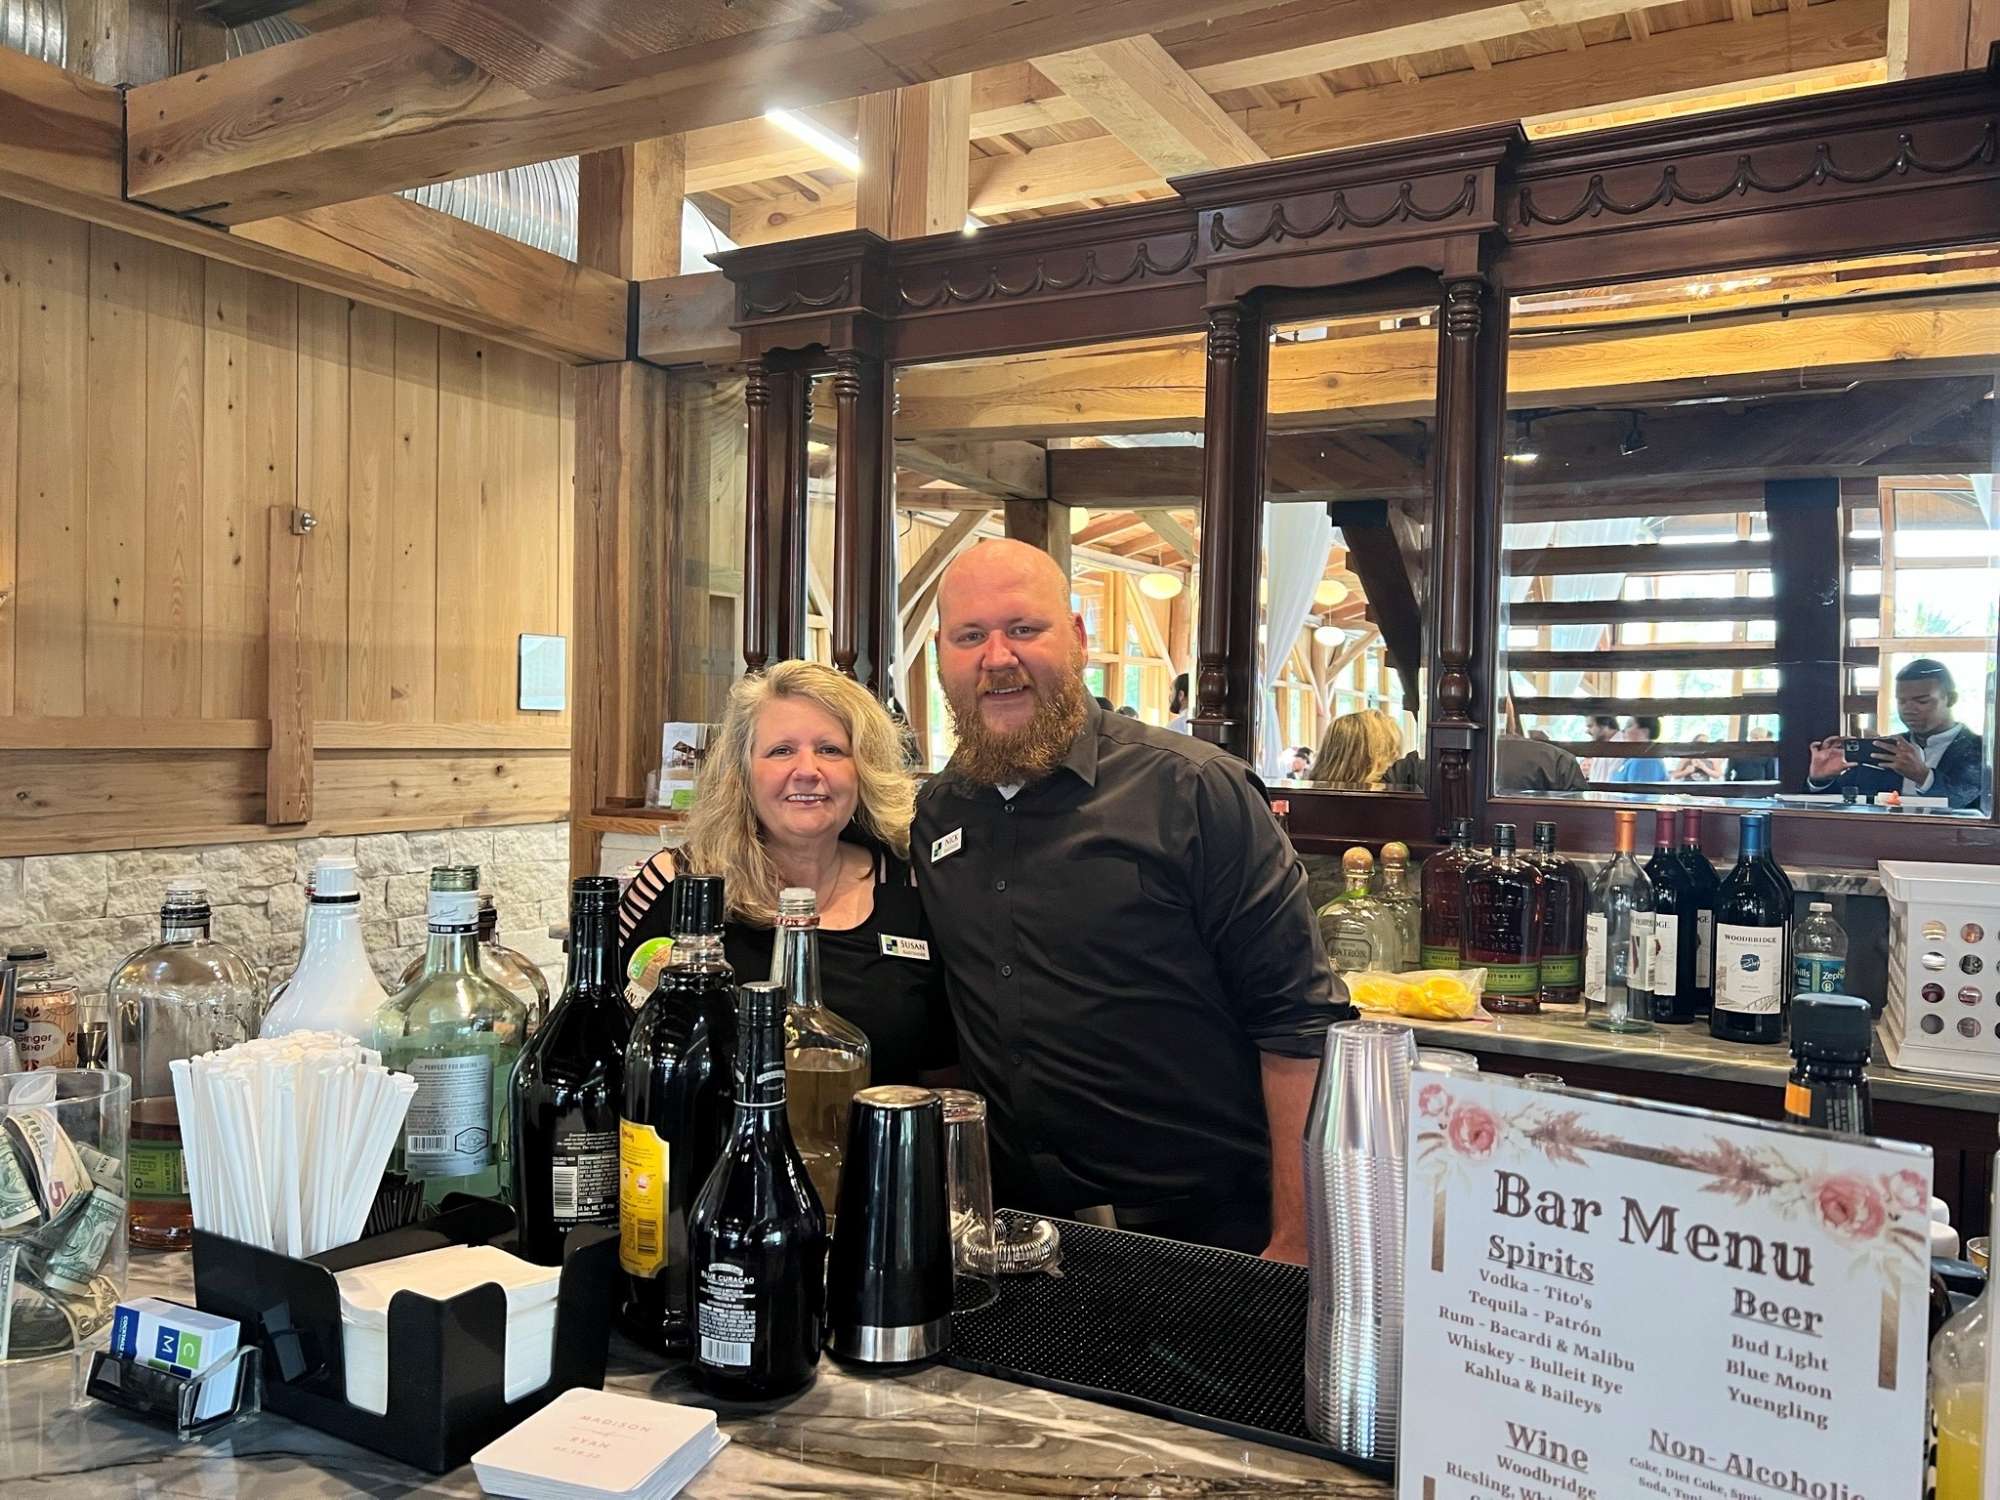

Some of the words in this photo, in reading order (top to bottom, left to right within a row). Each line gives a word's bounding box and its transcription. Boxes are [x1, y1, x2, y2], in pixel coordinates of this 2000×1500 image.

[900, 940, 925, 951] SUSAN
[1724, 933, 1777, 944] WOODBRIDGE
[16, 1034, 52, 1044] Ginger
[20, 1043, 46, 1052] Beer
[1492, 1169, 1602, 1234] Bar
[1618, 1196, 1815, 1286] Menu
[1488, 1234, 1595, 1283] Spirits
[1479, 1268, 1529, 1293] Vodka
[1544, 1285, 1592, 1310] Tito's
[1468, 1290, 1528, 1317] Tequila
[1544, 1310, 1602, 1338] Patrón
[1732, 1287, 1823, 1335] Beer
[163, 1335, 175, 1353] M
[183, 1342, 195, 1359] C
[1438, 1305, 1475, 1327] Rum
[1489, 1319, 1551, 1349] Bacardi
[1556, 1338, 1569, 1353] &
[1573, 1343, 1635, 1372] Malibu
[1731, 1333, 1769, 1356] Bud
[1775, 1344, 1830, 1372] Light
[1447, 1331, 1514, 1364] Whiskey
[1530, 1355, 1586, 1383] Bulleit
[1591, 1373, 1624, 1395] Rye
[1726, 1358, 1770, 1384] Blue
[1775, 1371, 1833, 1400] Moon
[1464, 1360, 1520, 1389] Kahlua
[1524, 1379, 1537, 1394] &
[1541, 1383, 1602, 1415] Baileys
[1727, 1385, 1829, 1431] Yuengling
[580, 1415, 652, 1433] MADISON
[1505, 1420, 1589, 1471] Wine
[1649, 1428, 1717, 1465] Non-
[1445, 1461, 1516, 1500] Riesling,
[1496, 1454, 1597, 1500] Woodbridge
[1629, 1456, 1662, 1477] Coke,
[1665, 1467, 1690, 1483] Diet
[1693, 1476, 1728, 1499] Coke,
[1638, 1476, 1671, 1497] Soda,
